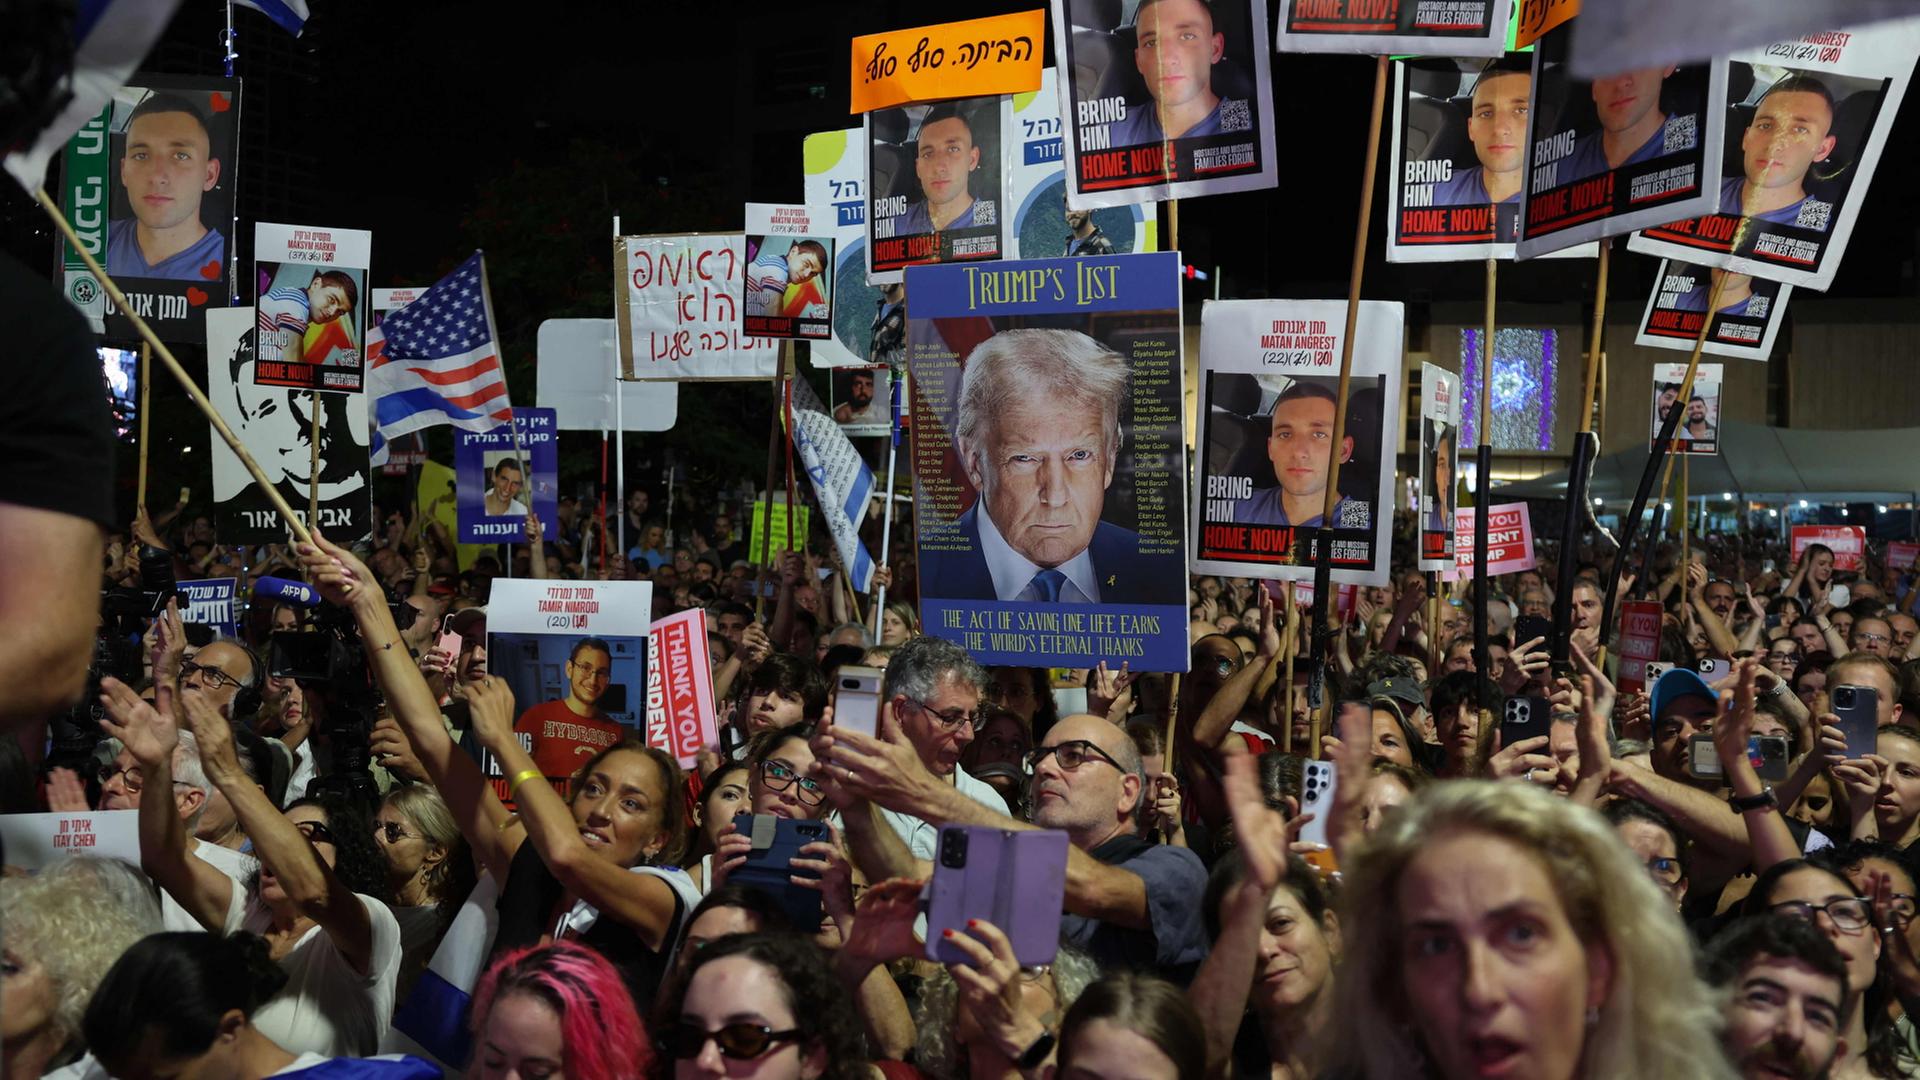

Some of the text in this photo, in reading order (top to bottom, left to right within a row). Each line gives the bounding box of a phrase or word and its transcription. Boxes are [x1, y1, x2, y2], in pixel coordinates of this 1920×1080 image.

[1296, 0, 1398, 20] HOME NOW!
[1418, 2, 1486, 12] HOSTAGES AND MISSING
[1416, 10, 1484, 26] FAMILIES FORUM
[1804, 32, 1852, 48] ANGREST
[1078, 96, 1126, 126] BRING
[1080, 125, 1111, 152] HIM
[1534, 129, 1576, 167] BRING
[1082, 140, 1177, 180] HOME NOW!
[1194, 150, 1254, 170] FAMILIES FORUM
[1220, 147, 1231, 156] AND
[1404, 159, 1452, 184] BRING
[1532, 163, 1559, 195] HIM
[1670, 163, 1696, 176] MISSING
[829, 178, 865, 198] הל
[1404, 184, 1434, 208] HIM
[1630, 172, 1695, 201] FAMILIES FORUM
[874, 195, 907, 219] BRING
[1530, 188, 1568, 225] HOME
[1571, 172, 1615, 212] NOW!
[1402, 210, 1448, 233] HOME
[1450, 203, 1497, 232] NOW!
[874, 218, 896, 240] HIM
[875, 240, 905, 262] HOME
[908, 232, 942, 256] NOW!
[1758, 232, 1785, 244] HOSTAGES
[1785, 237, 1796, 246] AND
[952, 243, 978, 256] FAMILIES
[1755, 240, 1818, 262] FAMILIES FORUM
[1662, 276, 1696, 293] BRING
[158, 294, 188, 321] מתן
[678, 286, 736, 326] הוא
[1656, 292, 1678, 309] HIM
[1272, 320, 1326, 334] מתן אנגרסט
[1650, 310, 1680, 330] HOME
[259, 330, 288, 347] BRING
[1261, 335, 1336, 350] MATAN ANGREST
[258, 346, 279, 360] HIM
[258, 362, 286, 378] HOME
[288, 364, 314, 381] NOW!
[530, 416, 549, 428] אין
[464, 433, 550, 446] סגן הר גולדין
[1207, 475, 1253, 499] BRING
[241, 510, 277, 529] אור
[1206, 500, 1235, 523] HIM
[1488, 513, 1520, 527] YOU
[473, 523, 518, 535] וענווה
[1204, 526, 1295, 554] HOME NOW!
[1336, 540, 1348, 548] AND
[1344, 550, 1369, 561] FORUM
[216, 586, 230, 598] עד
[280, 584, 300, 598] AFP
[547, 588, 594, 599] תמיר נמרודי
[538, 600, 600, 614] TAMIR NIMRODI
[546, 616, 570, 629] (20)
[942, 608, 1160, 635] THE ACT OF SAVING ONE LIFE EARNS
[963, 631, 1144, 656] THE WORLD'S ETERNAL THANKS
[648, 633, 670, 754] PRESIDENT
[669, 624, 700, 756] THANK YOU
[60, 819, 92, 834] איתי חן
[53, 834, 96, 848] ITAY CHEN
